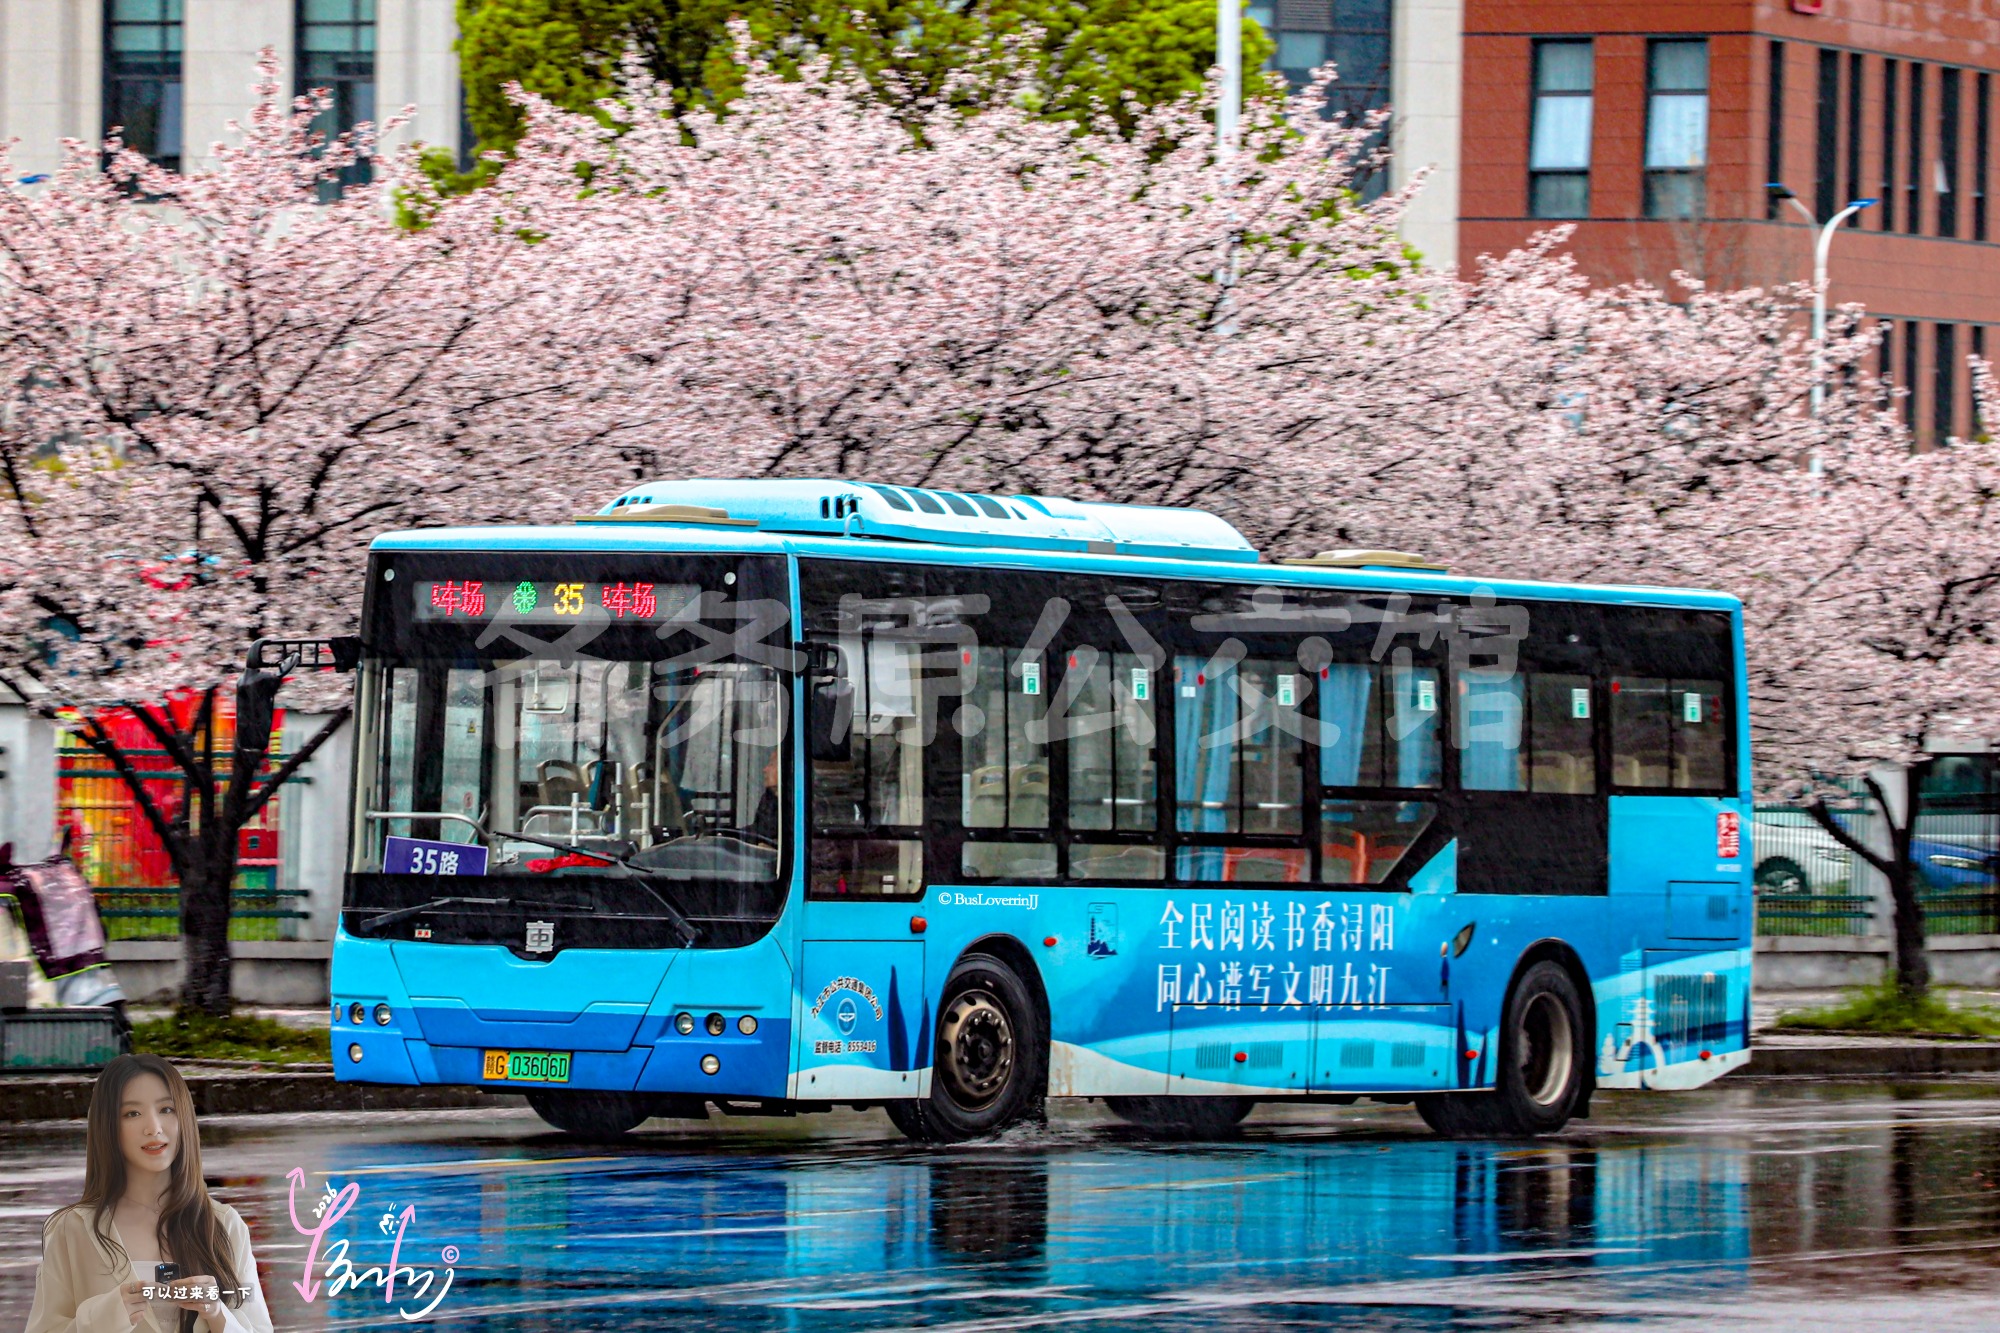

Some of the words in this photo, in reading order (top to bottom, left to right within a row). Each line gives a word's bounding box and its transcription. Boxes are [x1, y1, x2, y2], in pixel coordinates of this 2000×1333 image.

[432, 580, 486, 616] 车场
[553, 583, 585, 615] 35
[602, 582, 657, 618] 车场
[410, 847, 459, 876] 35路
[1158, 900, 1393, 951] 全民阅读书香浔阳
[1157, 961, 1393, 1012] 同心谱写文明九江
